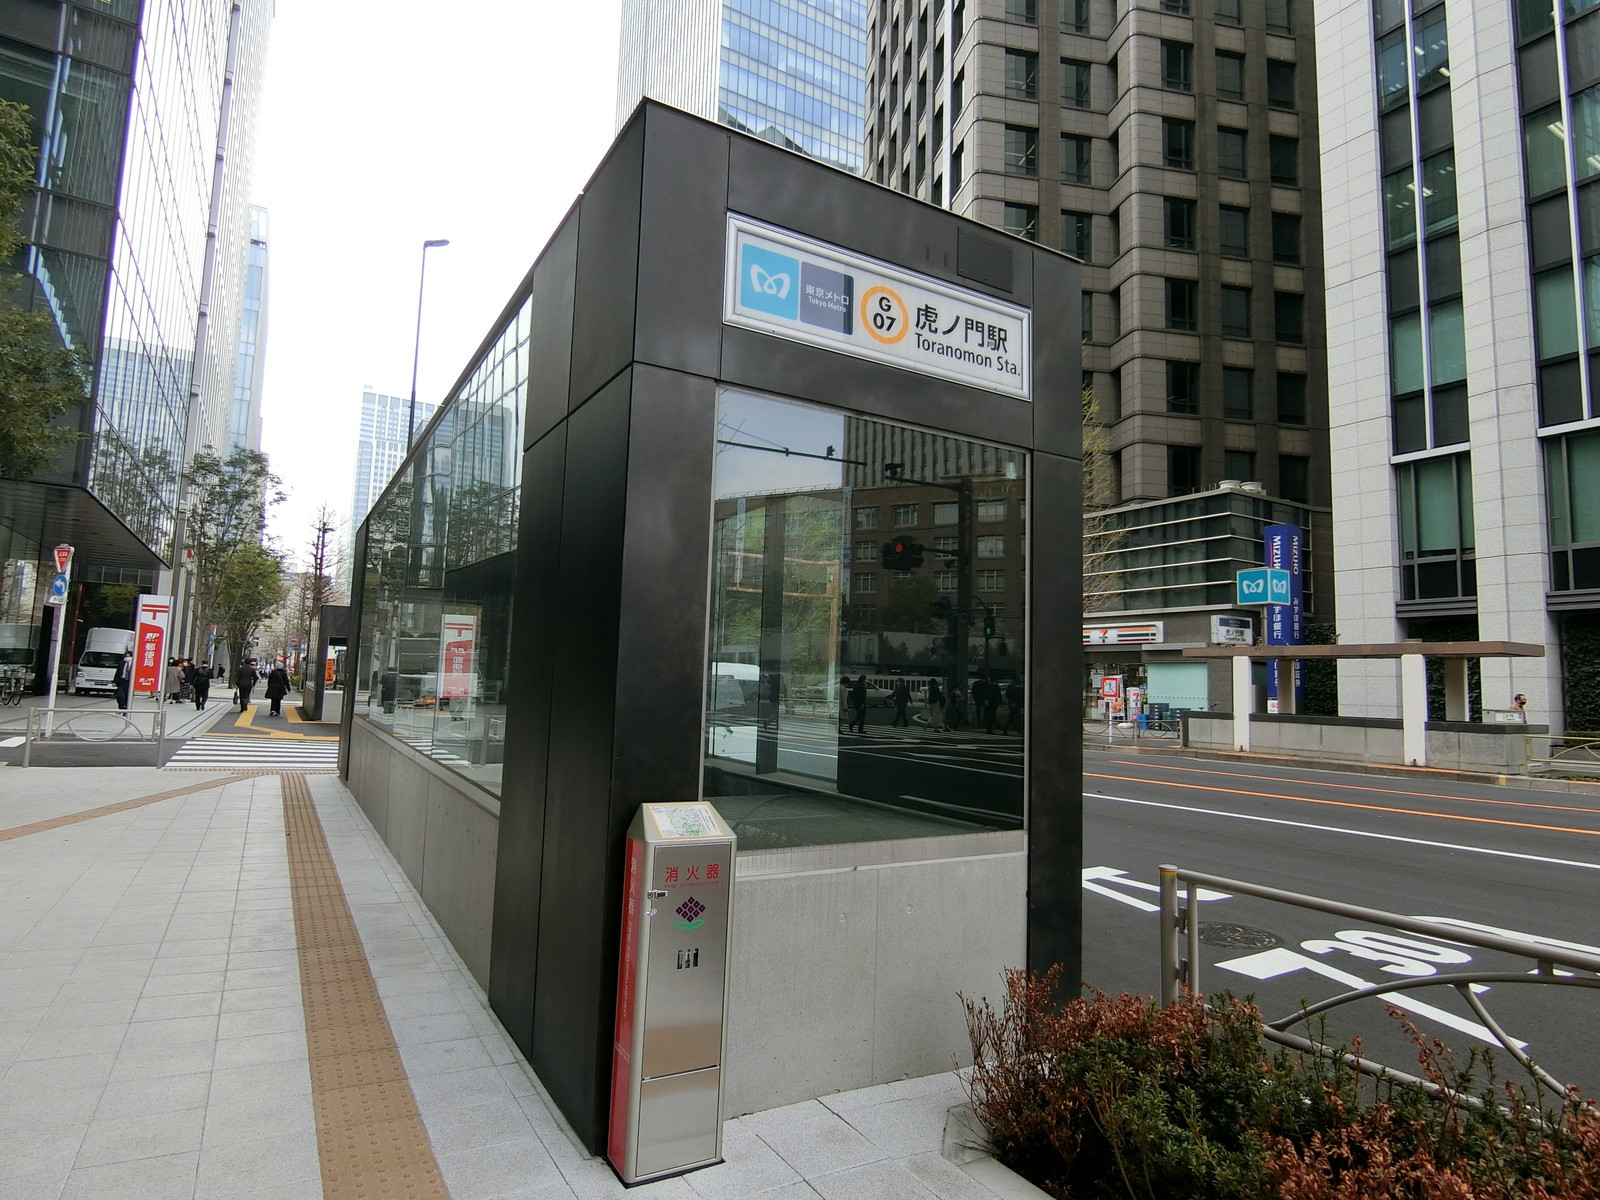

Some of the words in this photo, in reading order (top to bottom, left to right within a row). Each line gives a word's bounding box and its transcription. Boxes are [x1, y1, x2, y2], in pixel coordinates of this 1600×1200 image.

[805, 284, 849, 305] 東京メトロ
[808, 296, 827, 310] Tokyo
[827, 301, 847, 313] Metro
[878, 296, 892, 312] G
[873, 312, 897, 333] 07
[915, 304, 1008, 354] 虎ノ門駅
[915, 333, 992, 369] Toranomon
[996, 354, 1021, 377] Sta.
[1272, 535, 1281, 570] MIZUH
[1273, 605, 1282, 639] ずほ銀行
[144, 642, 155, 667] 郵便局
[665, 863, 719, 882] 消火器
[1300, 929, 1473, 977] 30
